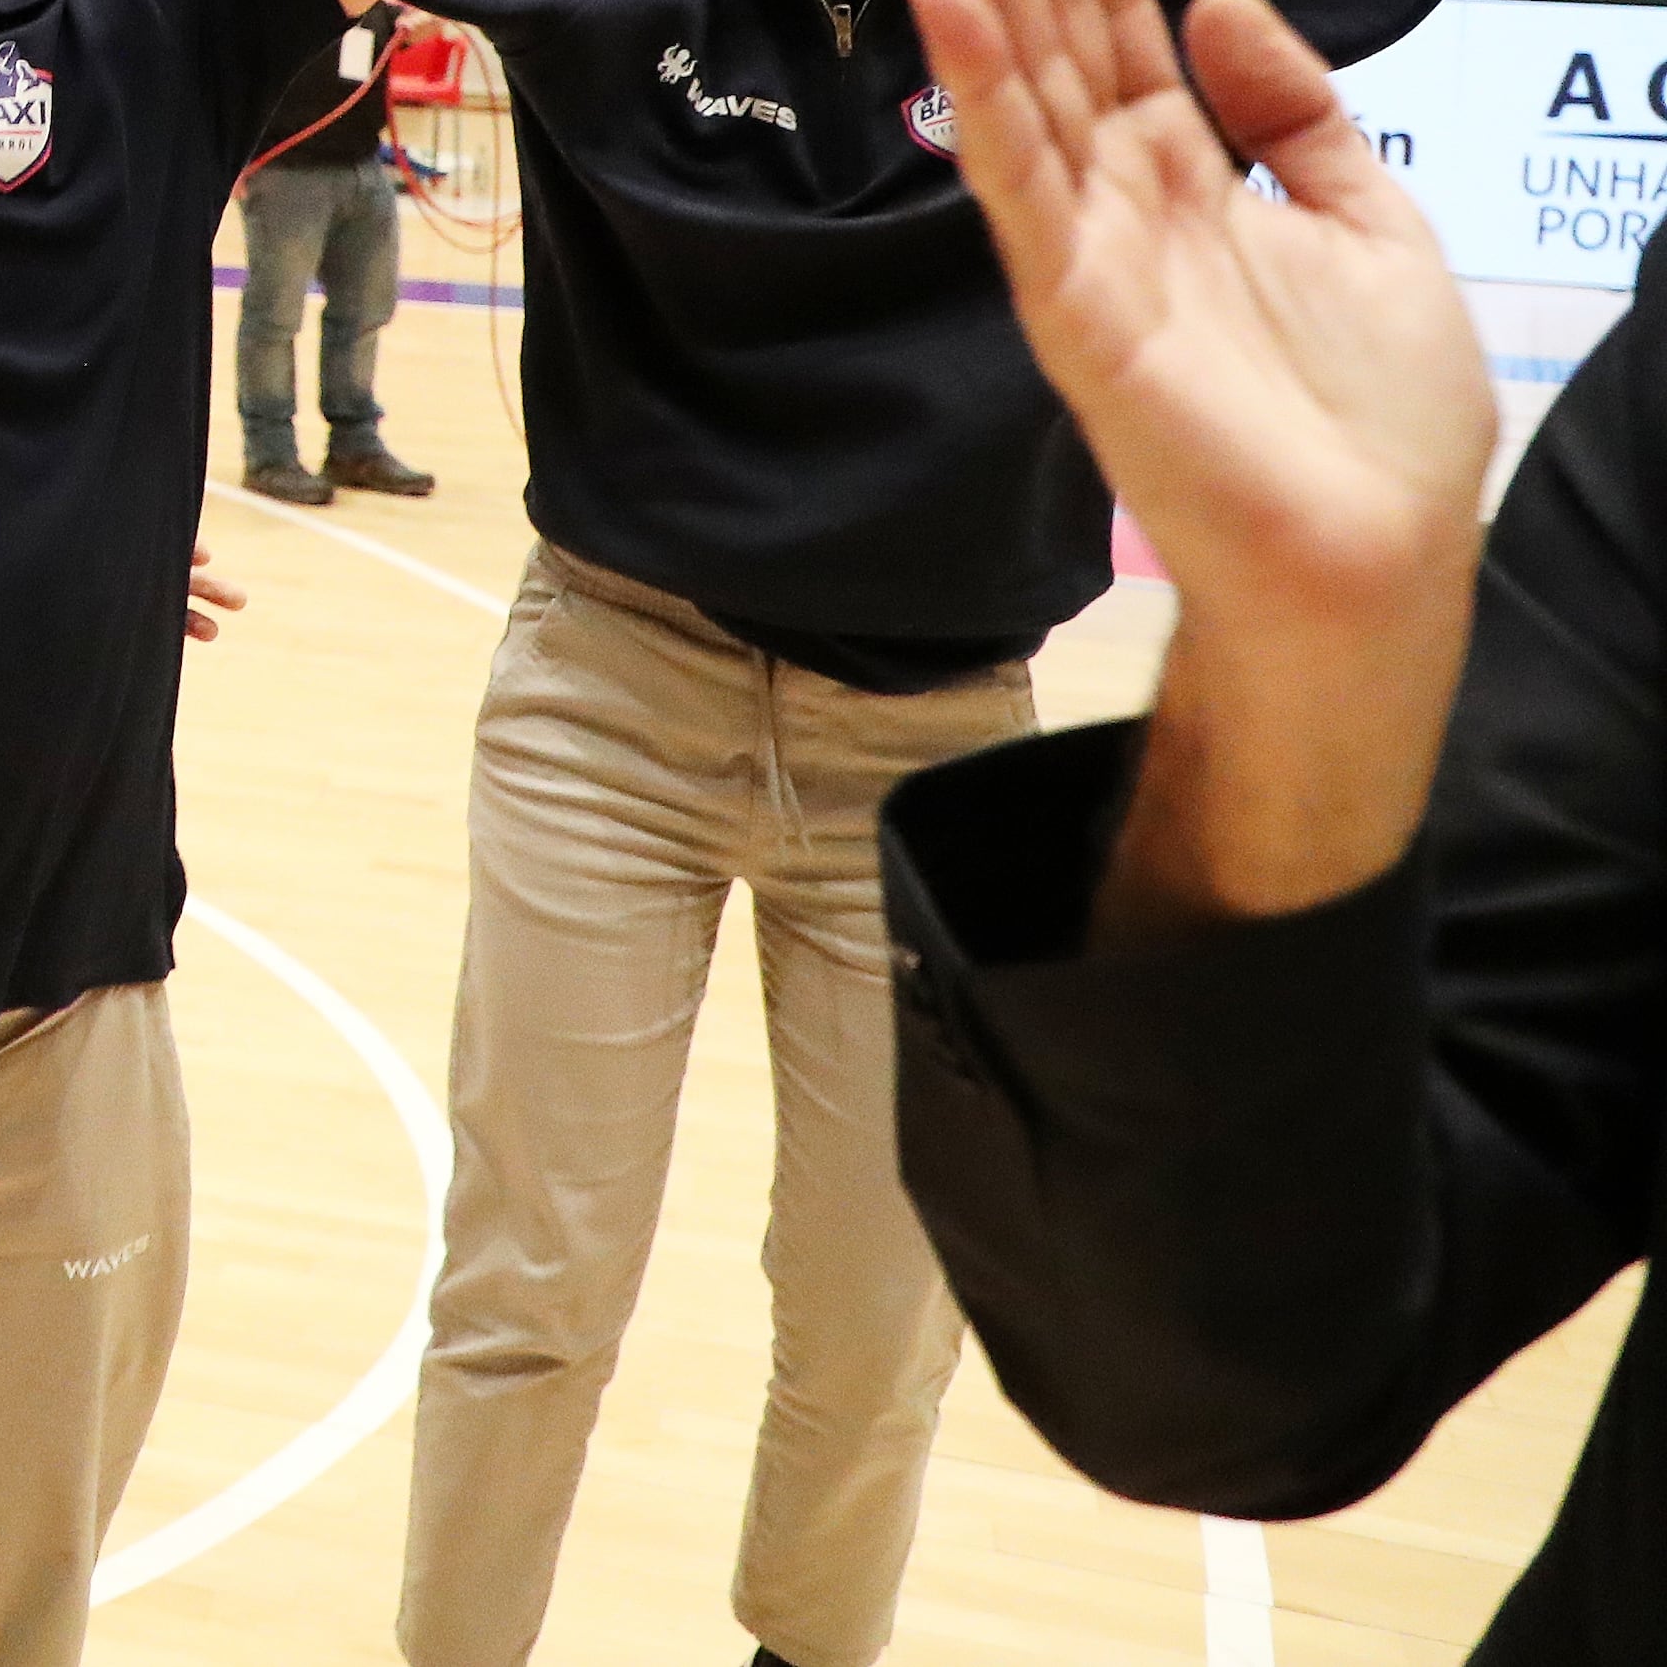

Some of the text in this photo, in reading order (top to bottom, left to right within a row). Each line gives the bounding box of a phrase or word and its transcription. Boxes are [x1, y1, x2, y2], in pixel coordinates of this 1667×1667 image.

[686, 77, 799, 132] WAVES
[920, 93, 955, 122] BA
[1546, 51, 1610, 121] A
[62, 1232, 152, 1280] WAVES
